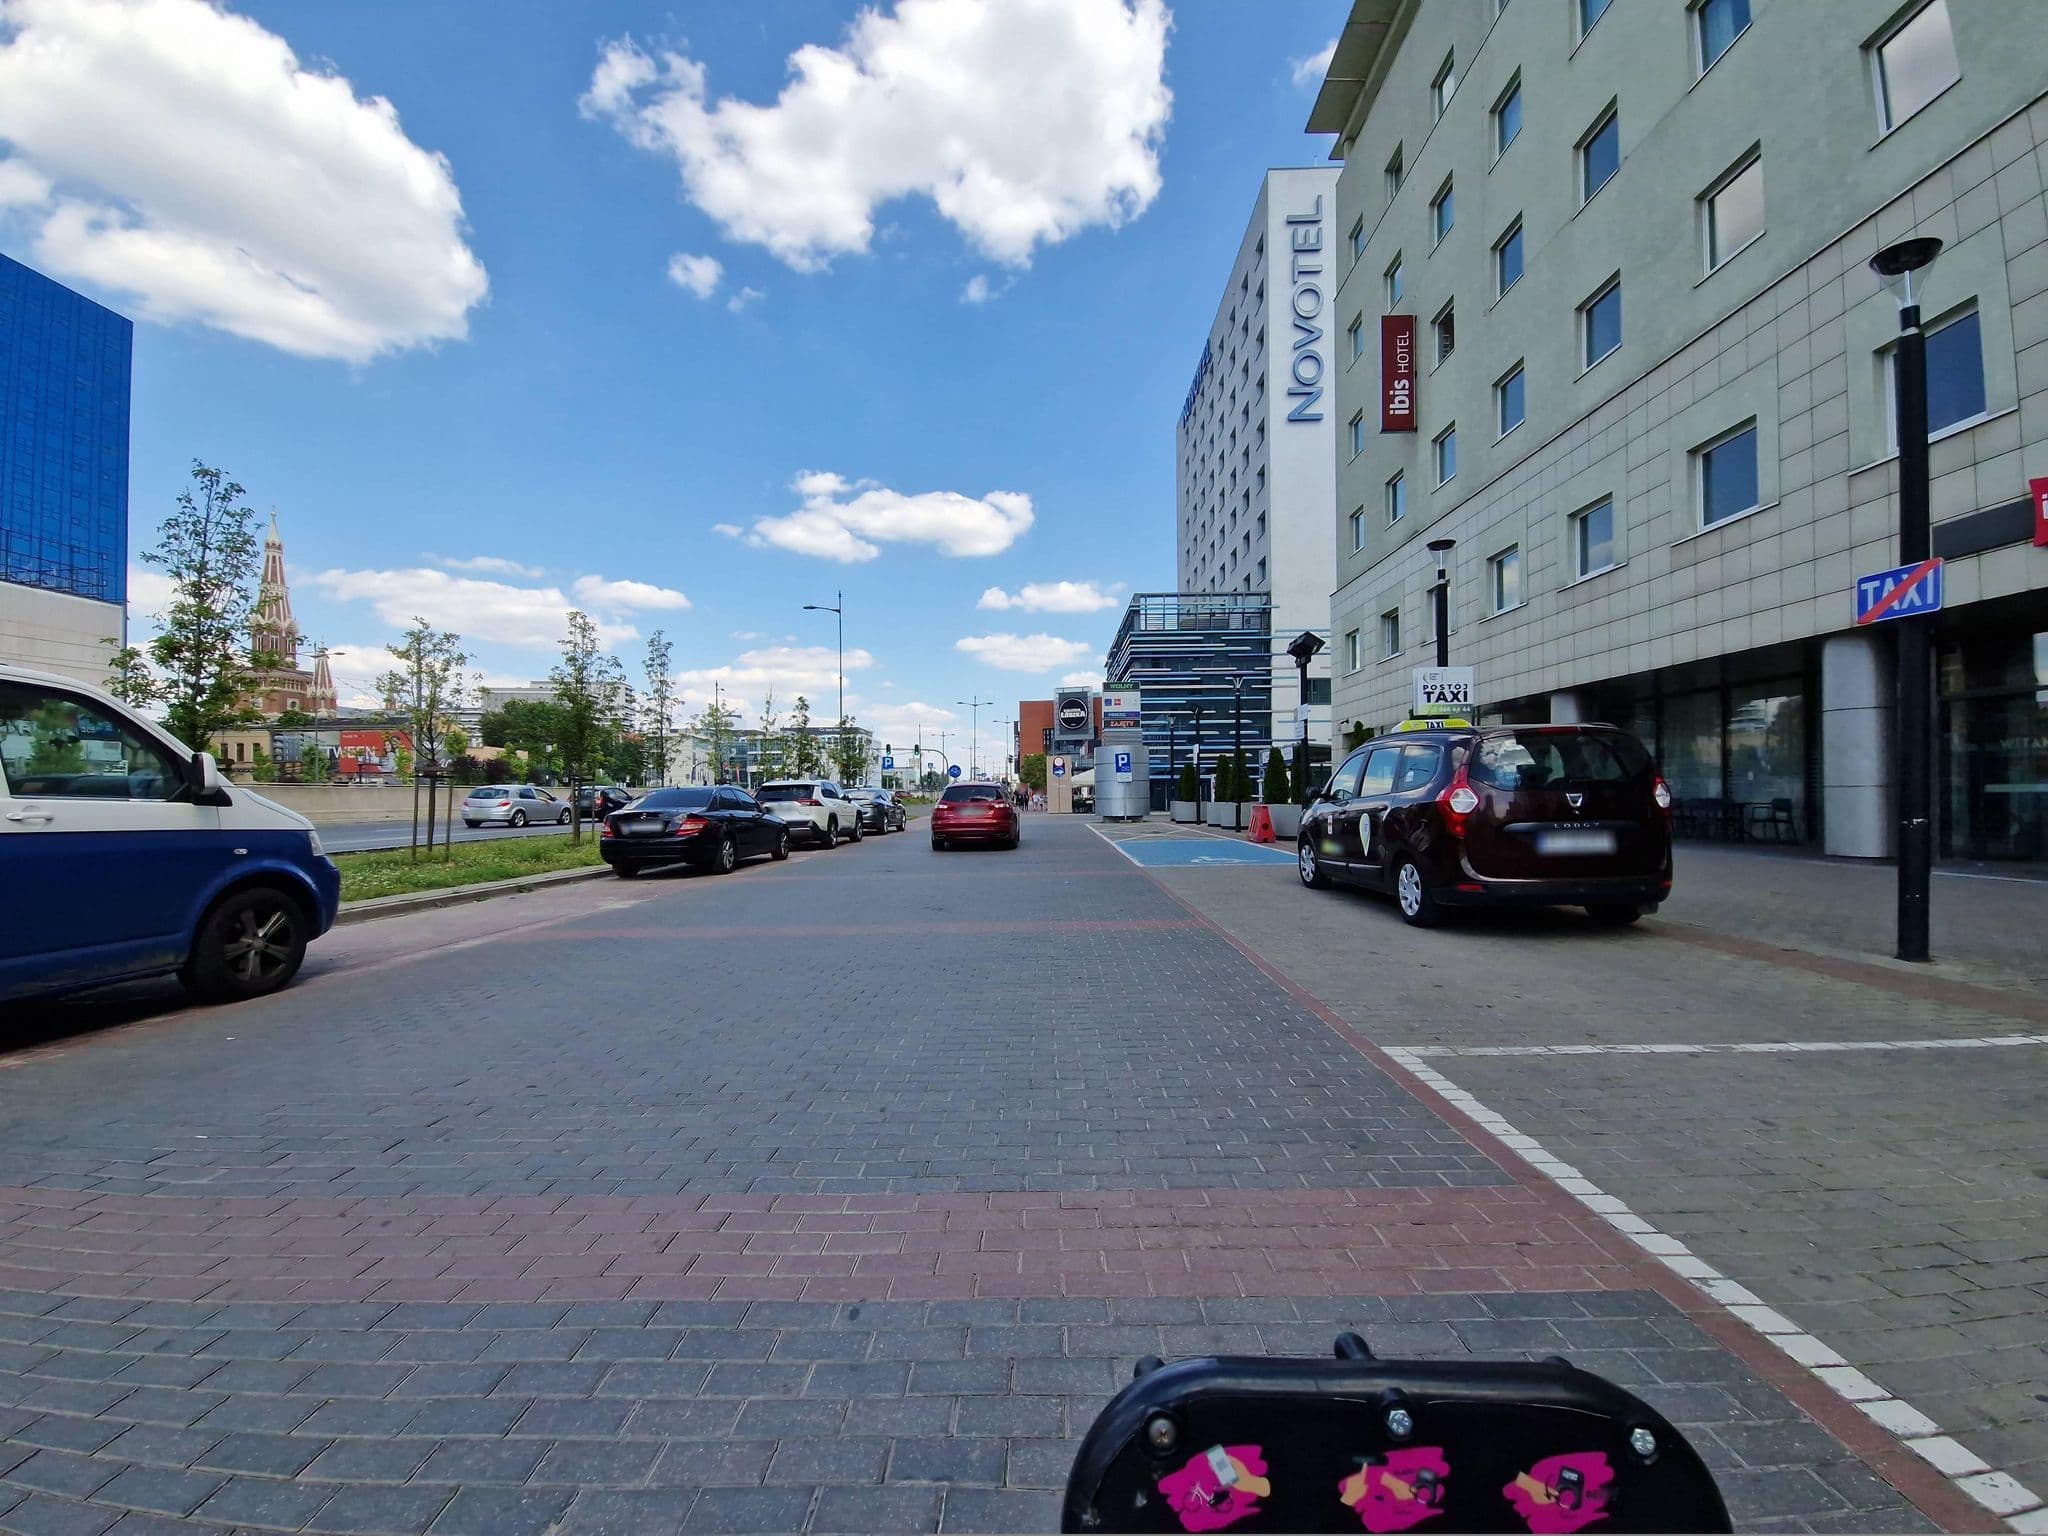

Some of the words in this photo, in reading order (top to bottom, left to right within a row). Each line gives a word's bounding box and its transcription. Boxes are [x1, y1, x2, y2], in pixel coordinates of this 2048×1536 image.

[1286, 194, 1324, 422] NOVOTEL
[1397, 331, 1409, 373] HOTEL
[1389, 379, 1409, 415] ibis
[1861, 569, 1934, 613] TAXI
[1423, 682, 1468, 691] POSTÓJ
[1423, 690, 1468, 703] TAXI
[1425, 721, 1444, 729] TAXI
[884, 758, 892, 767] P
[1118, 754, 1128, 767] P
